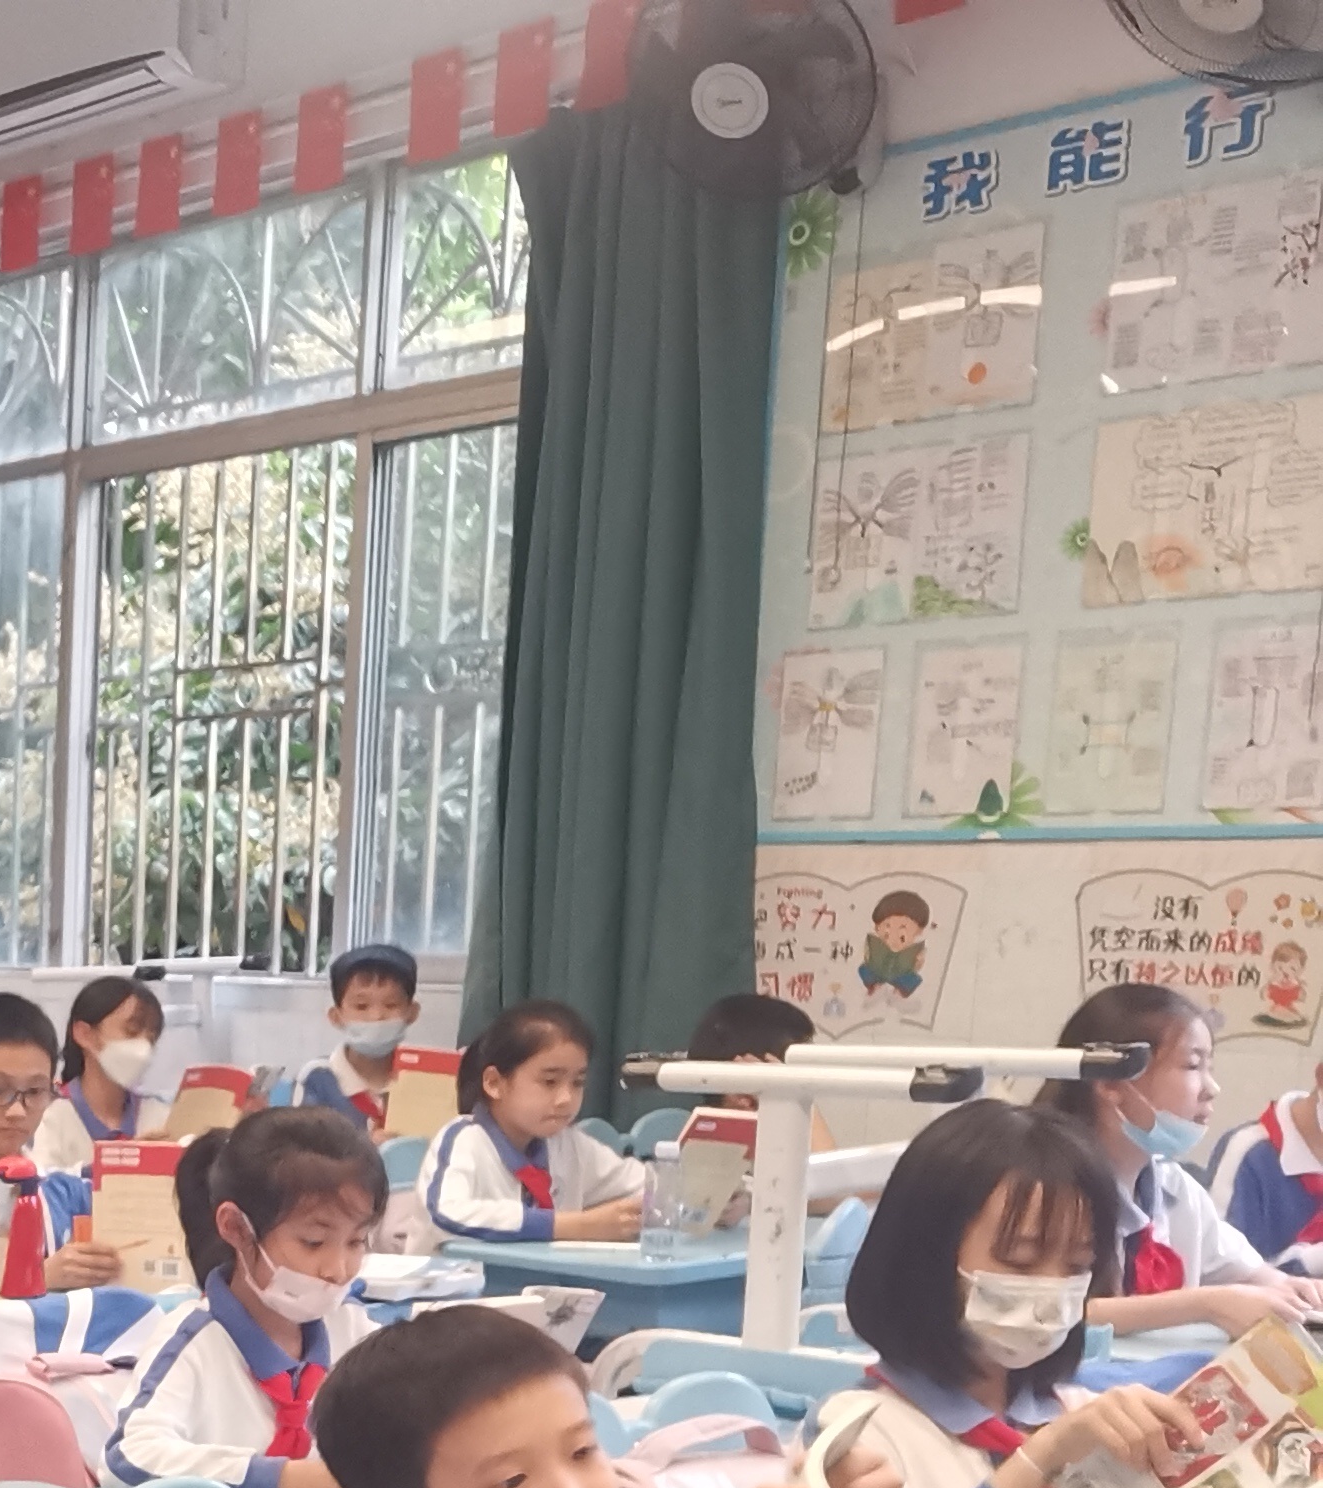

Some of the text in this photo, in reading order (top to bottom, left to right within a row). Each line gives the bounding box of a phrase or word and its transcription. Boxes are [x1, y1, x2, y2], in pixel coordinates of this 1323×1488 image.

[922, 88, 1274, 222] 我能行
[1153, 895, 1203, 921] 没有
[1088, 925, 1262, 956] 凭空而来的成绩
[1087, 958, 1261, 988] 只有持之以恒的
